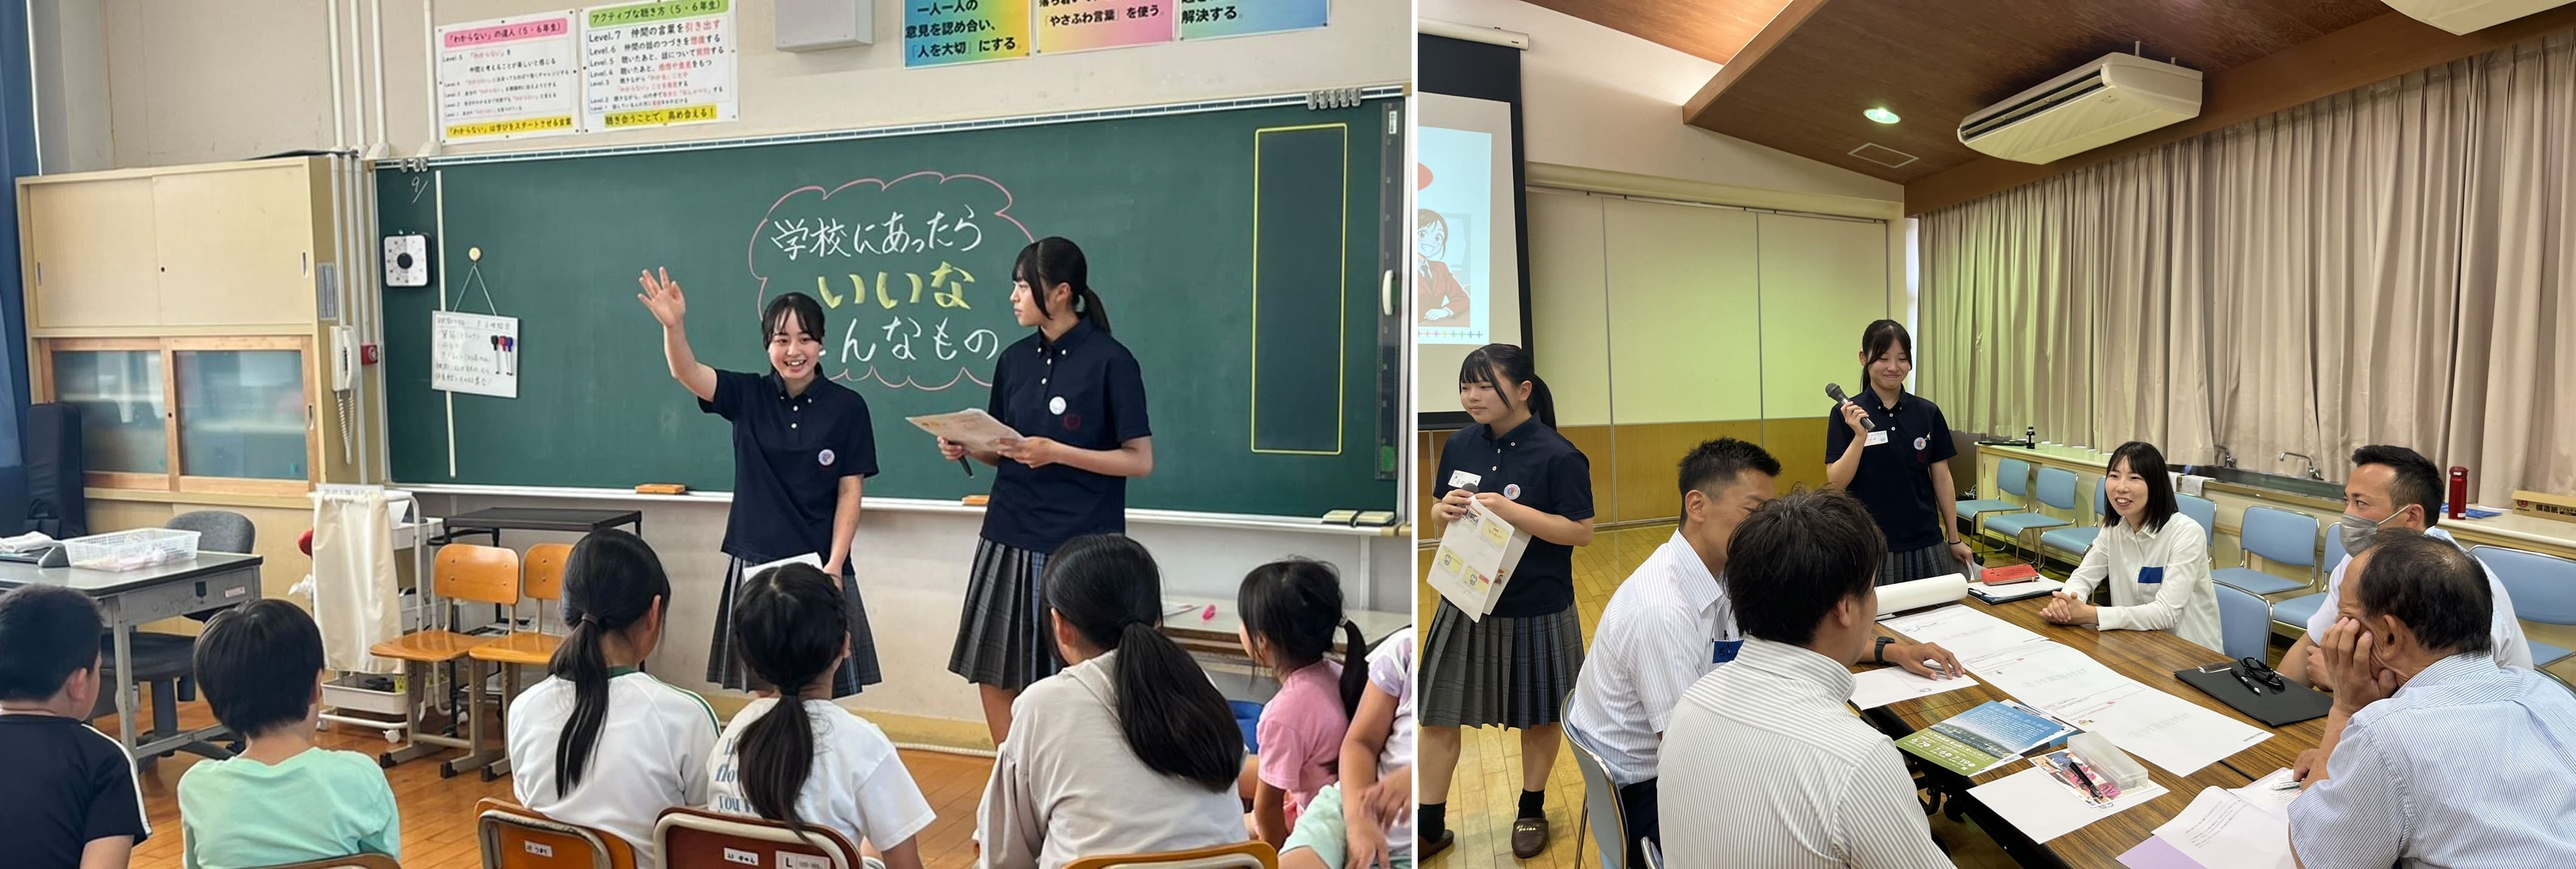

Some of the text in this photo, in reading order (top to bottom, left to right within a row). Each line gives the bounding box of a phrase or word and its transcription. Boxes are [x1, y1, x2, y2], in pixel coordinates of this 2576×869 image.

[917, 0, 978, 16] 一人一人の
[589, 19, 720, 43] Level.7 仲間の言葉を引き出す
[905, 19, 995, 39] 意見を認め合い、
[589, 46, 616, 56] Level.6
[771, 204, 982, 260] 学校にあったら
[817, 261, 975, 309] いいな
[819, 317, 998, 363] んなもの
